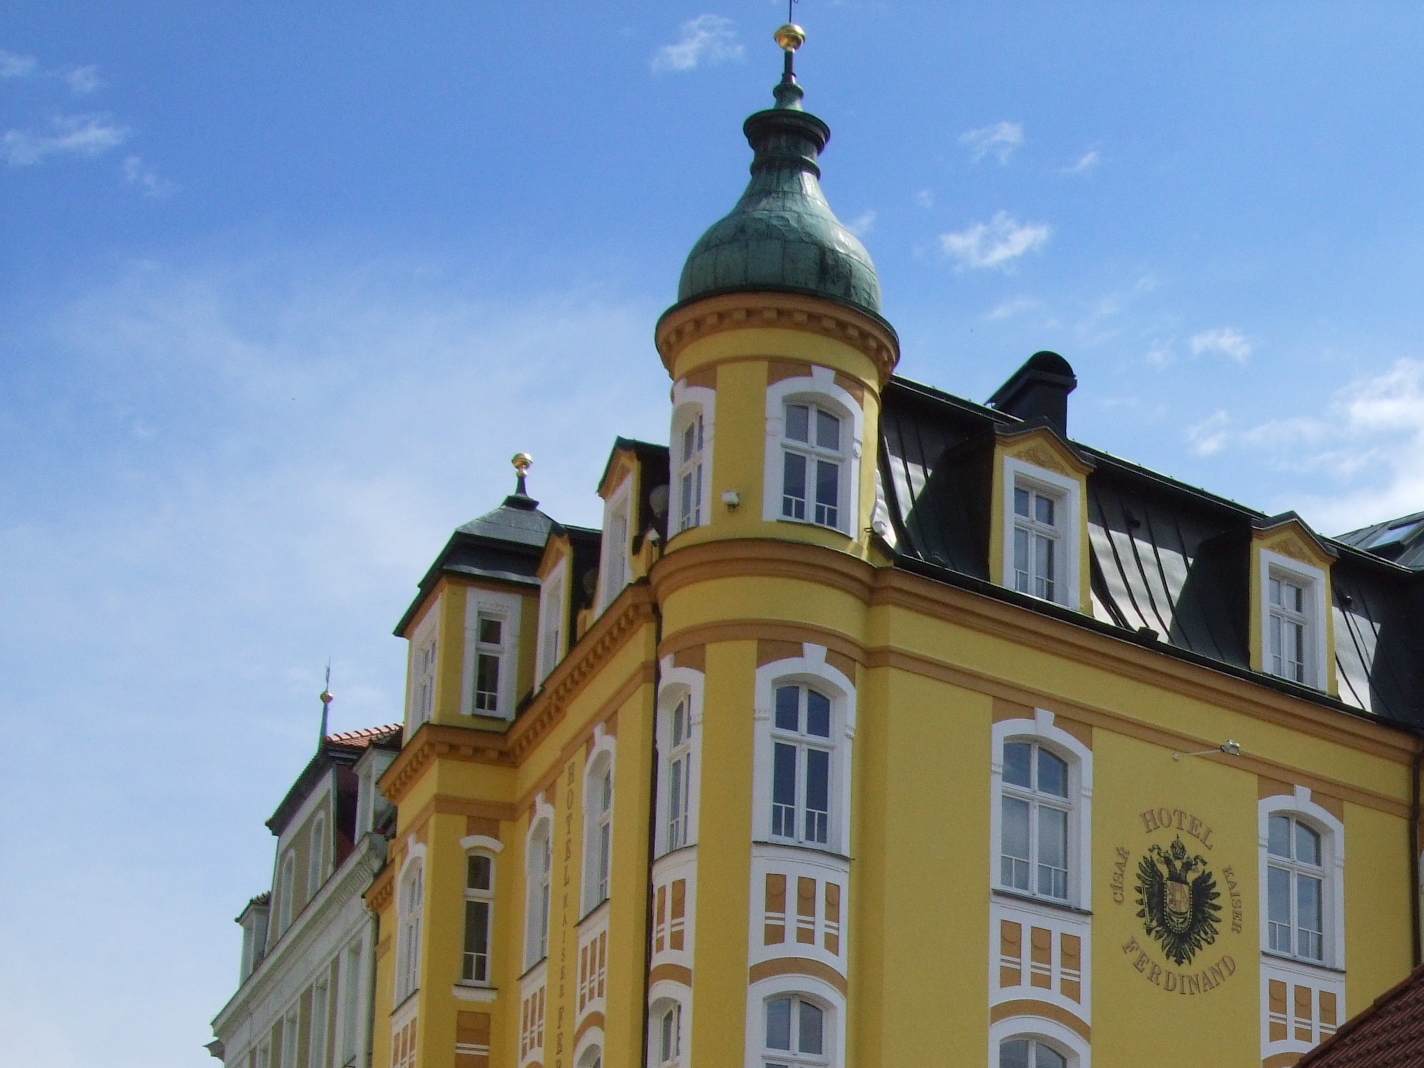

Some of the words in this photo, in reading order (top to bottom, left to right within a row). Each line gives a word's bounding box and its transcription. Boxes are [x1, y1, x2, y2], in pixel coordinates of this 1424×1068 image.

[565, 762, 576, 886] HOTEL
[1139, 807, 1215, 850] HOTEL
[1222, 864, 1244, 934] KAISER
[1121, 935, 1237, 996] FERDINAND
